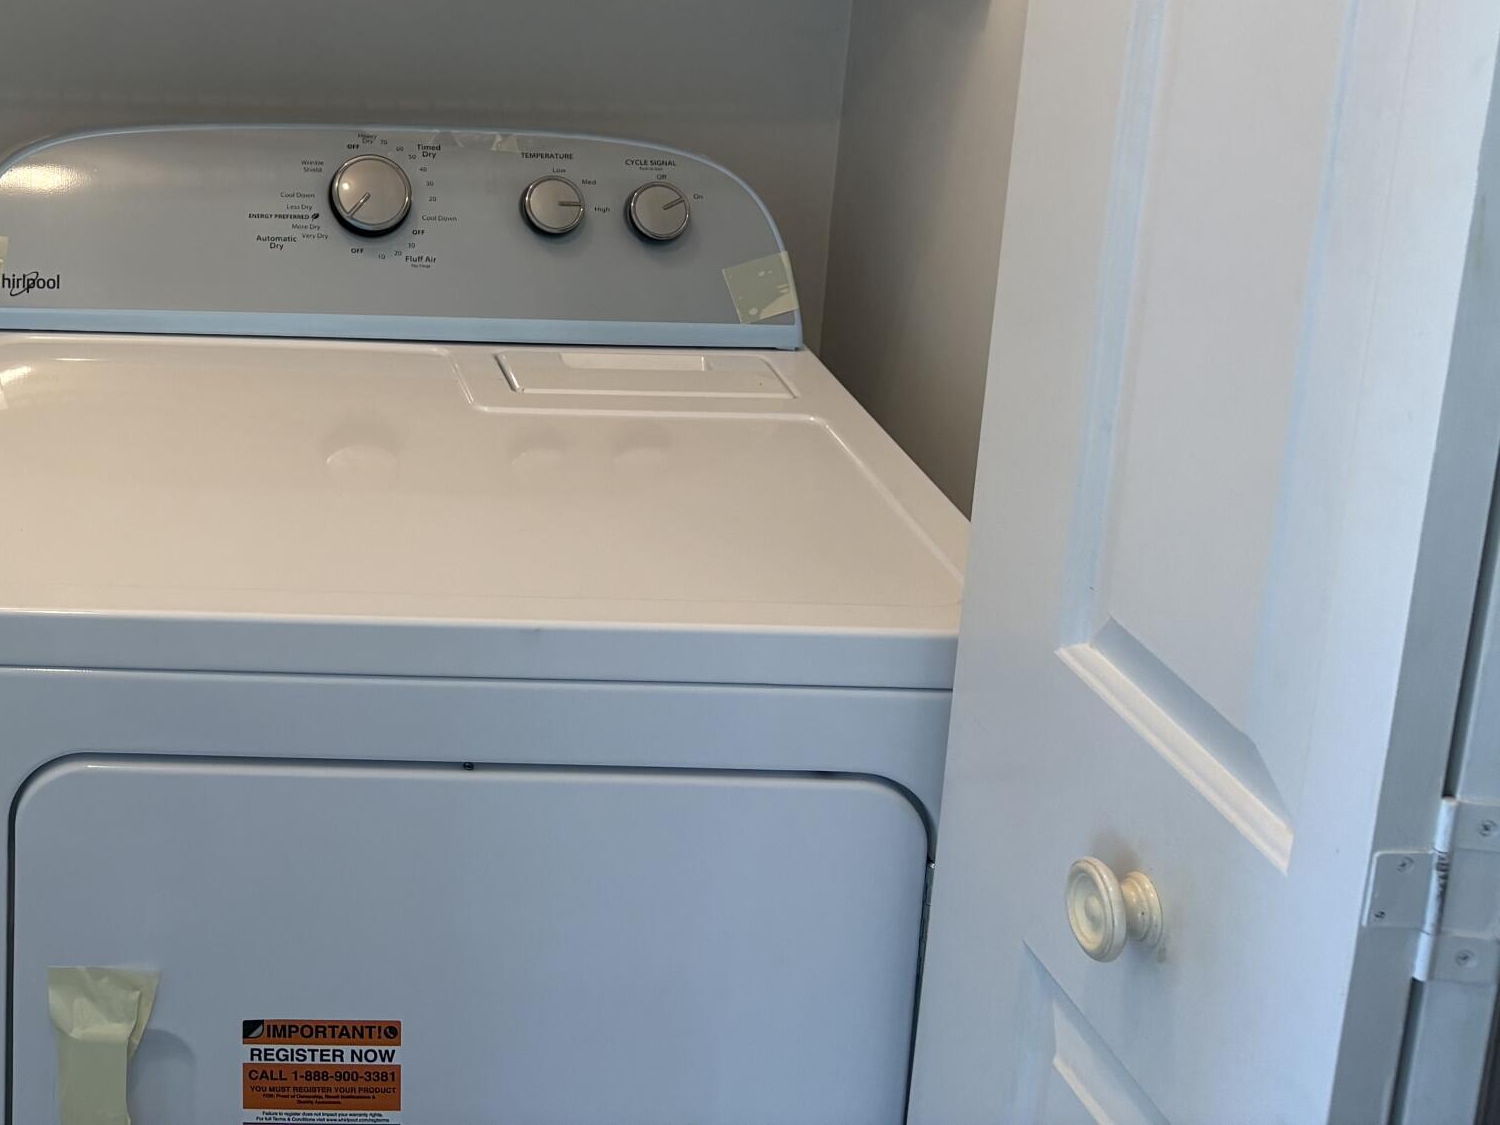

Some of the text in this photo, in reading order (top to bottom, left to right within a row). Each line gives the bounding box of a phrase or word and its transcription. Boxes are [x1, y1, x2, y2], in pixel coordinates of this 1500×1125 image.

[417, 143, 441, 151] Timed
[422, 151, 437, 160] Dry
[521, 152, 573, 160] TEMPERATURE
[256, 235, 297, 243] Automatic
[269, 242, 284, 251] Dry
[405, 255, 424, 263] Fluff
[266, 1024, 382, 1039] IMPORTANT!
[250, 1048, 395, 1063] REGISTER NOW
[248, 1069, 396, 1082] CALL 1-888-900-3381
[250, 1085, 267, 1093] YOU
[292, 1086, 332, 1094] REGISTER
[334, 1086, 356, 1094] YOUR
